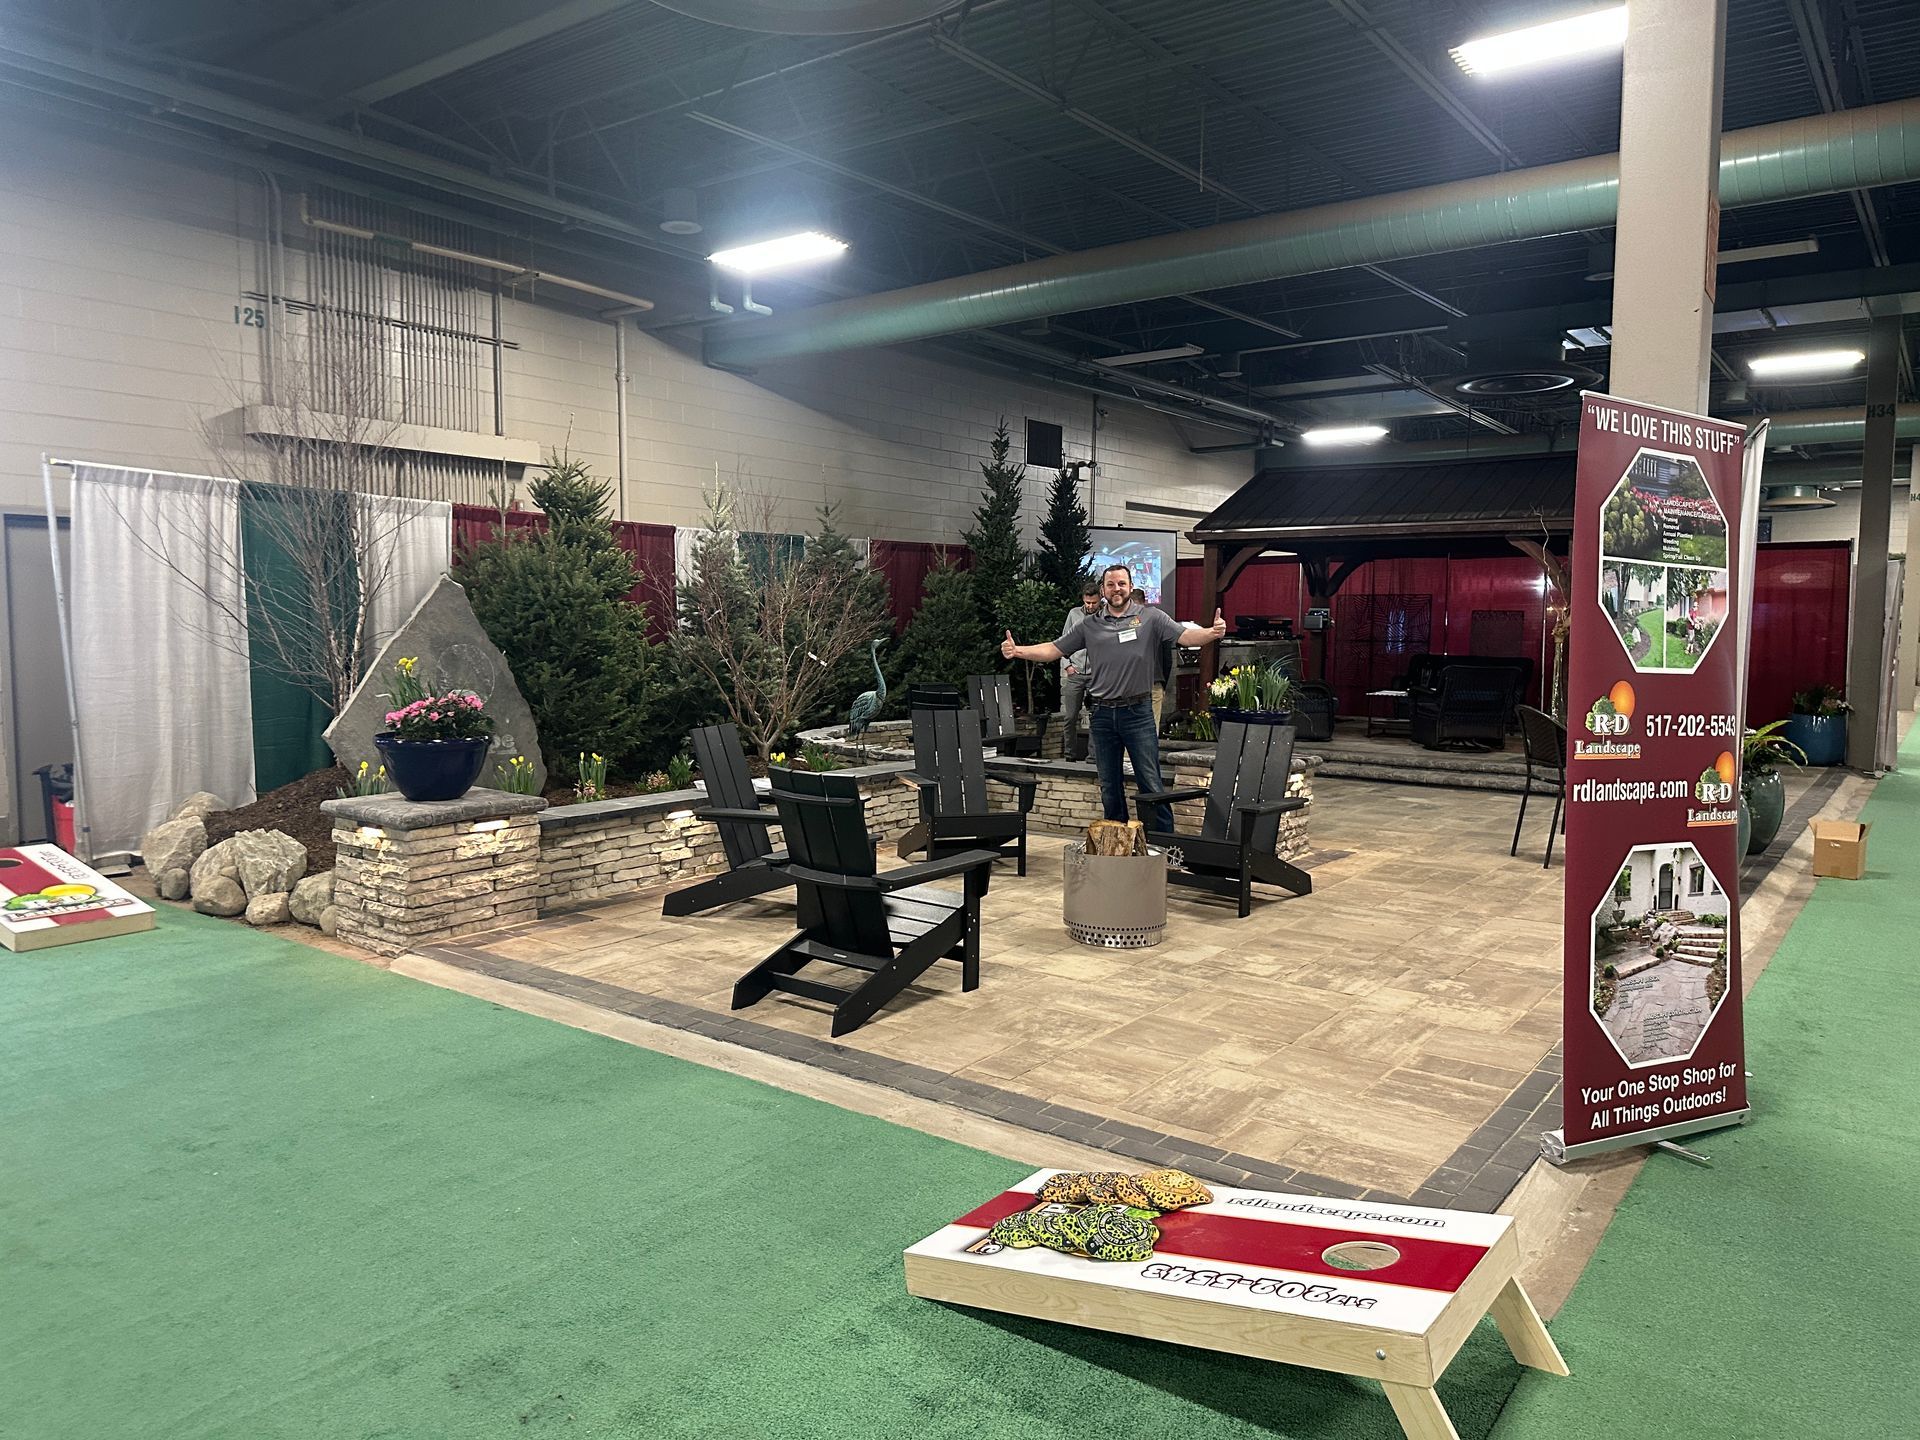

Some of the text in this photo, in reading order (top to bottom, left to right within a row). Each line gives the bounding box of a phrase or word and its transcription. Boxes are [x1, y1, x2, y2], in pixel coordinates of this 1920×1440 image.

[234, 305, 265, 328] 125
[1867, 403, 1896, 418] H34
[1623, 411, 1658, 441] LOVE
[1661, 419, 1692, 447] THIS
[1646, 714, 1736, 738] 517-202-5543
[1574, 740, 1641, 758] Landscape
[1573, 778, 1688, 804] rdlandscape.com
[1581, 1062, 1737, 1105] Your One Stop Shop for
[1590, 1086, 1727, 1130] All Things Outdoors!
[1225, 1197, 1446, 1228] rdlandscape.com
